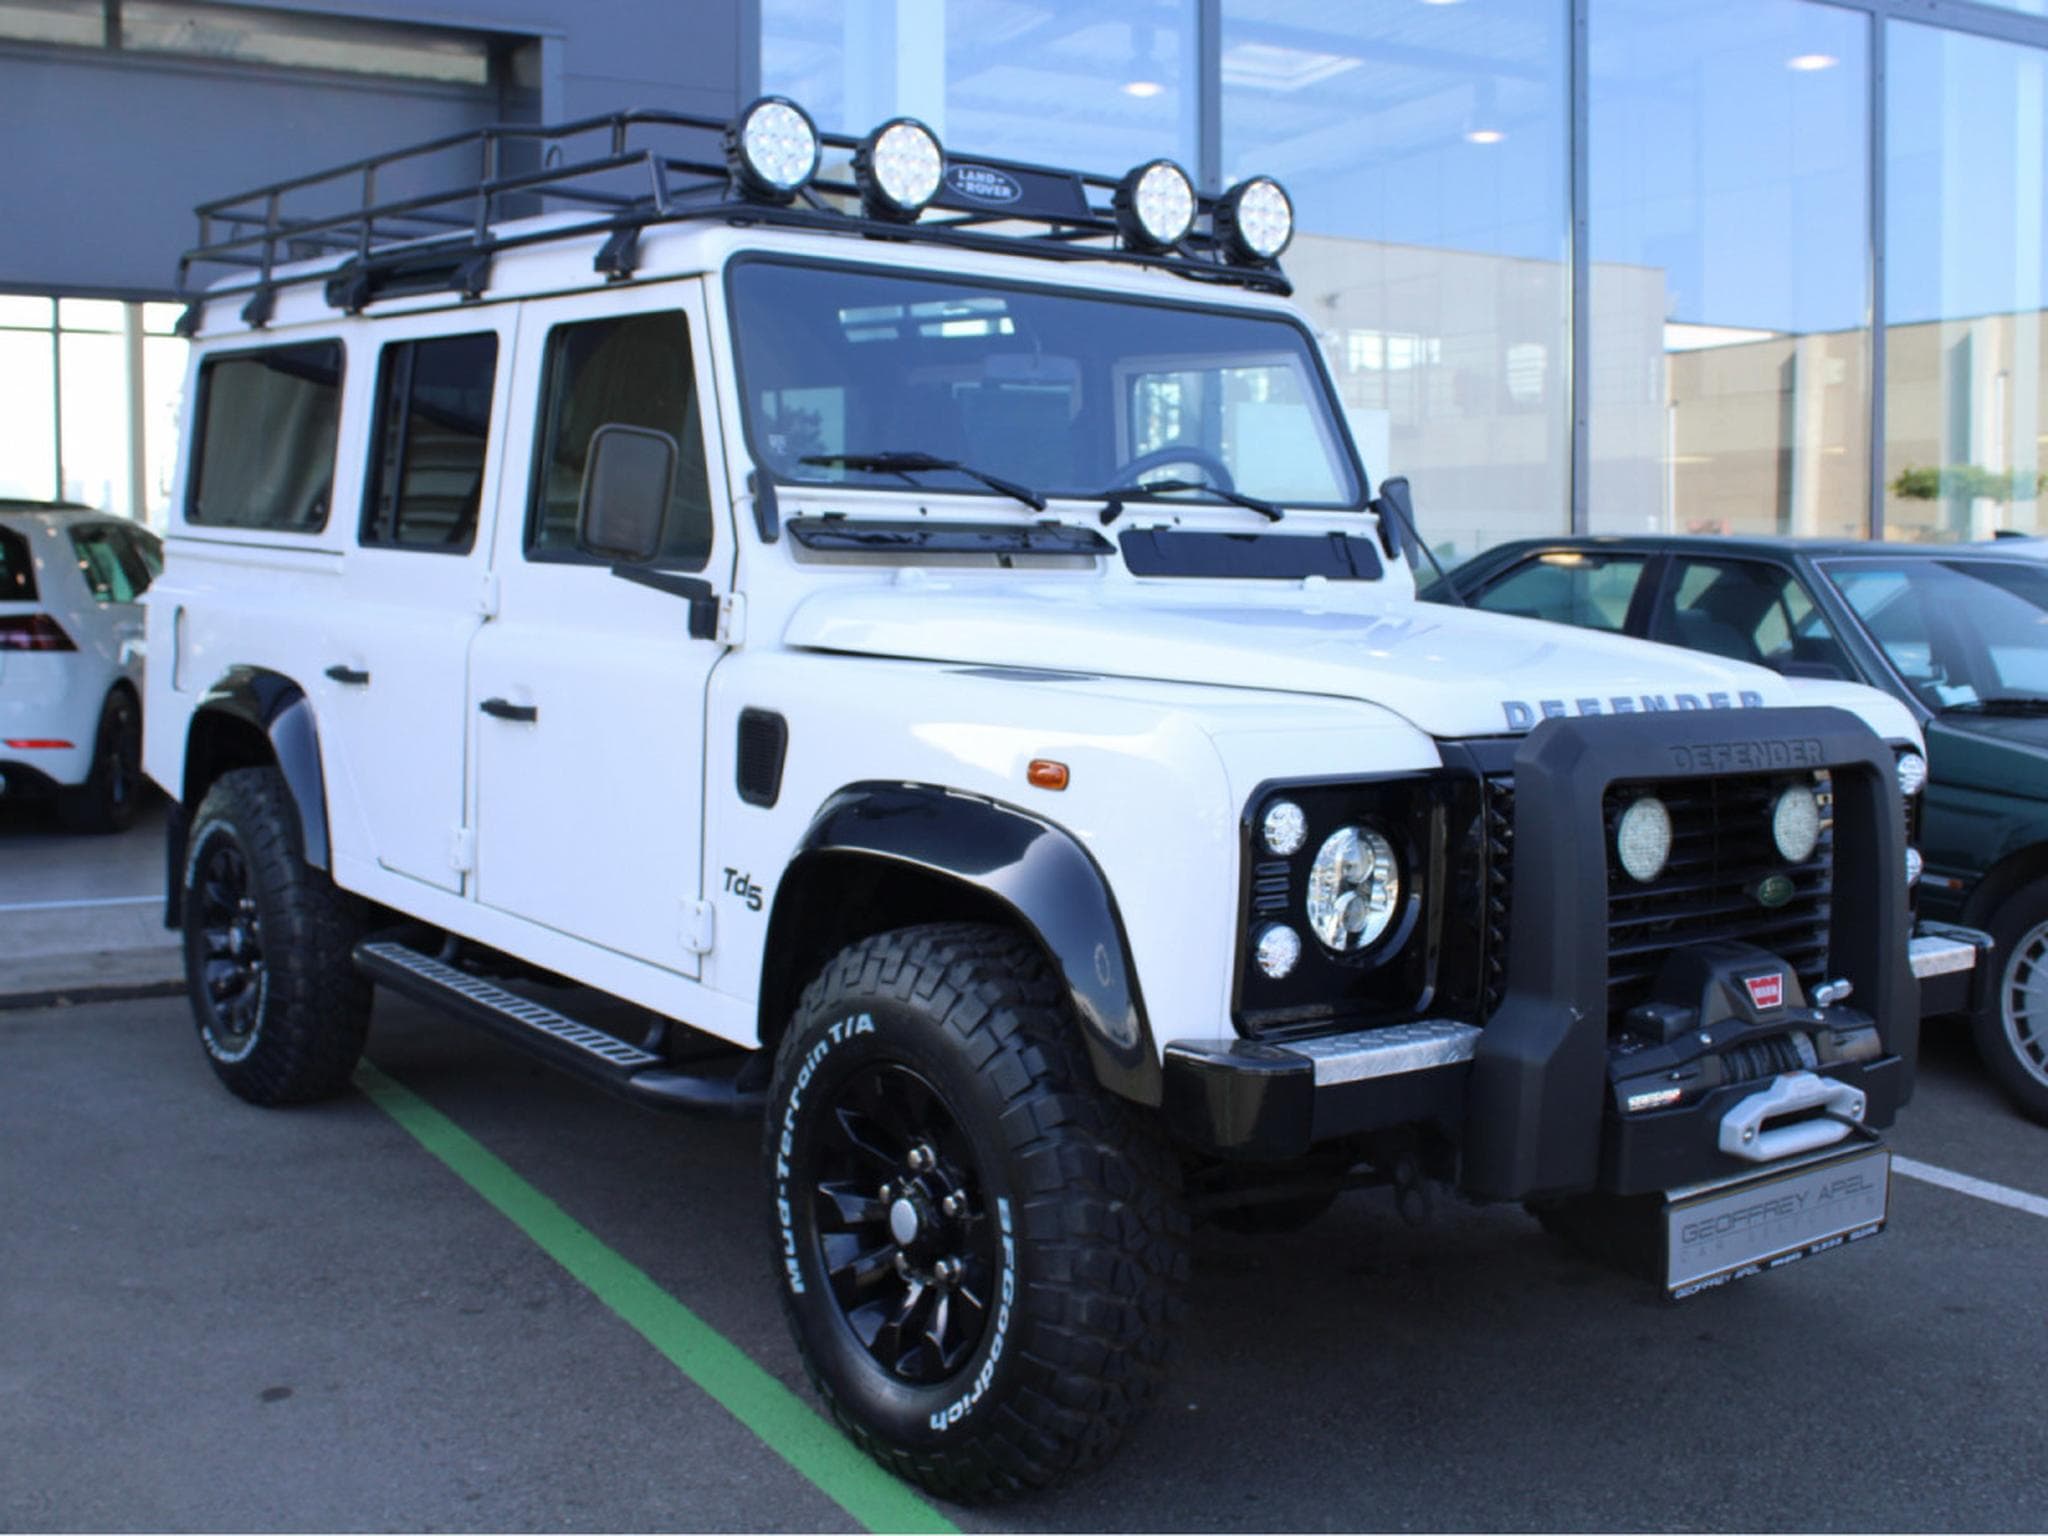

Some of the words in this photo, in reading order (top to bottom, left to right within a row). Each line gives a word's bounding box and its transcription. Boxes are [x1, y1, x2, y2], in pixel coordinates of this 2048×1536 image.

[1669, 738, 1824, 771] DEFENDER
[723, 866, 763, 912] Td5
[776, 1039, 830, 1294] Mud-Terrain
[828, 1013, 876, 1045] T/A
[1681, 1192, 1810, 1244] GEOFFREY
[1817, 1174, 1875, 1202] APEL
